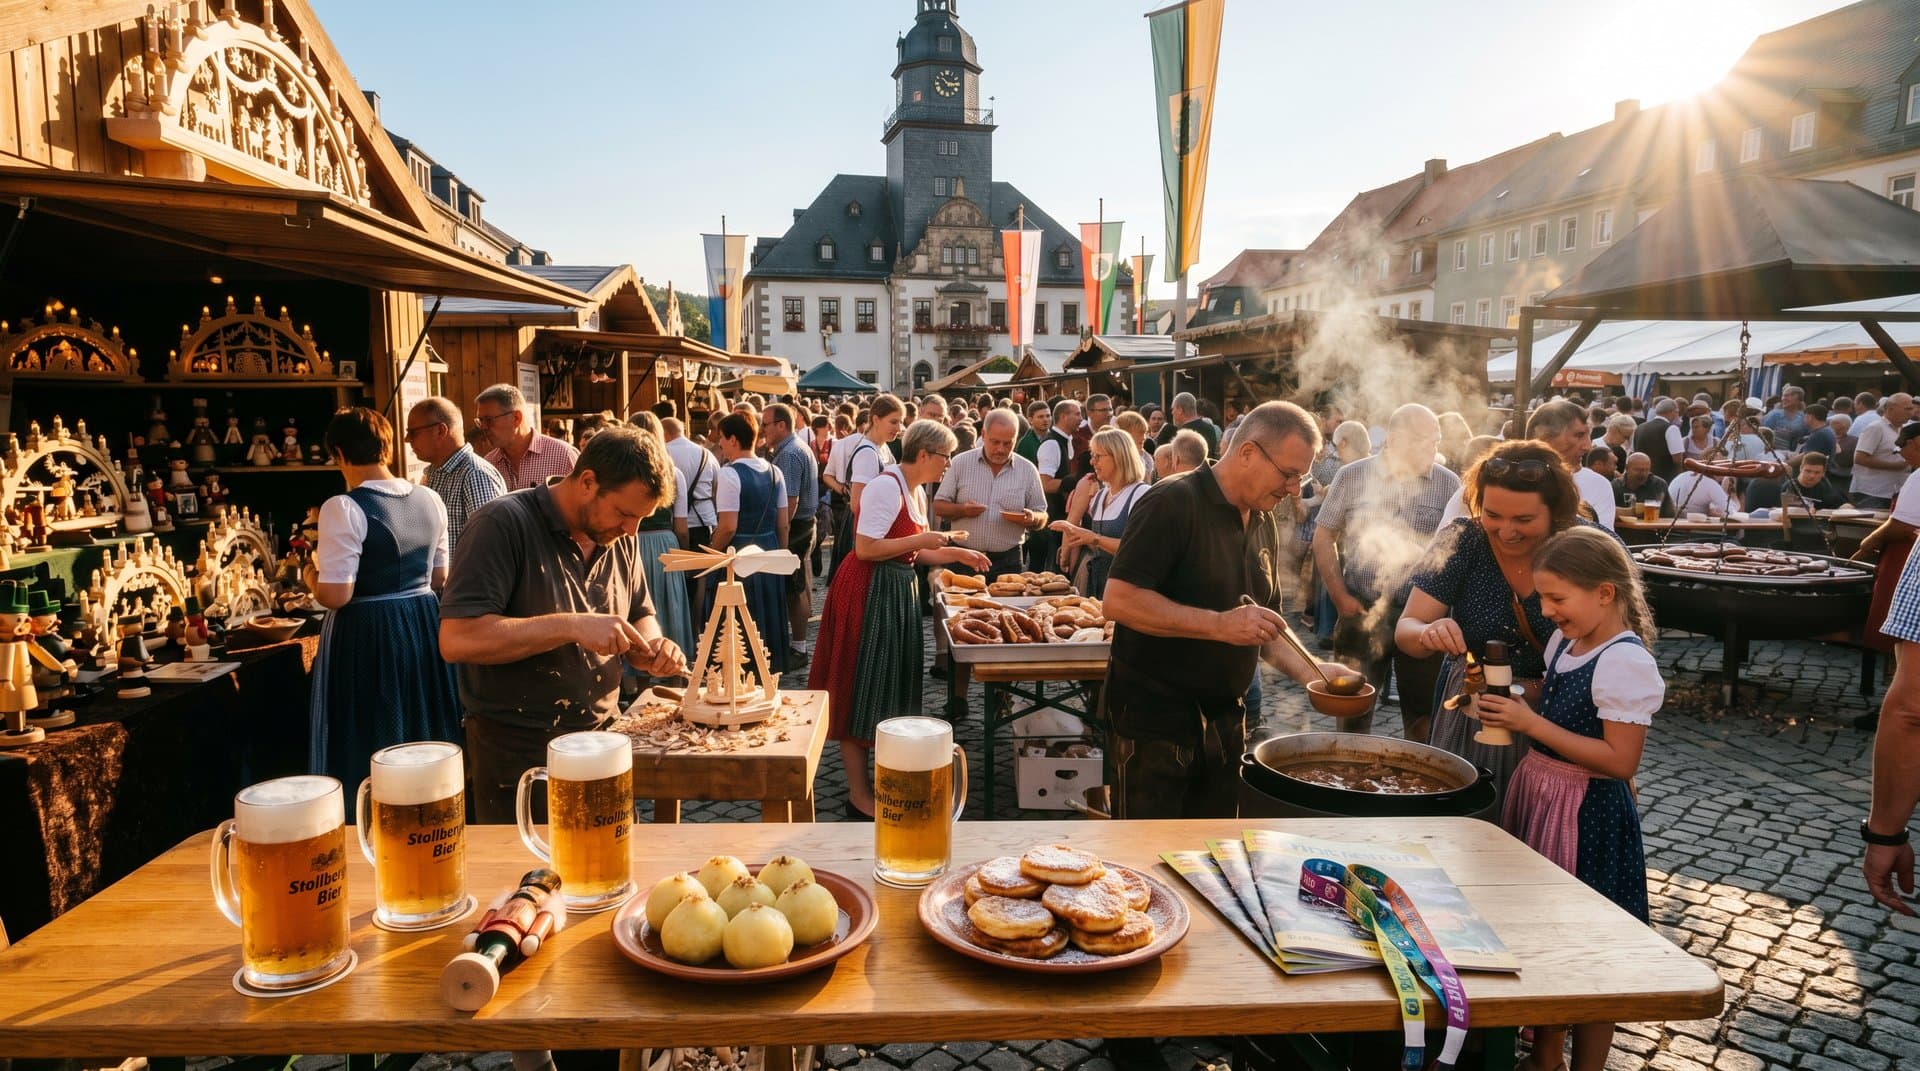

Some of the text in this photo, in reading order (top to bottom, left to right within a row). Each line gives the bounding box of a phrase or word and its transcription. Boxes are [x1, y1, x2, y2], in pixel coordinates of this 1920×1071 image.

[882, 807, 904, 822] Bier
[432, 842, 457, 858] Bier
[316, 885, 342, 906] Bier
